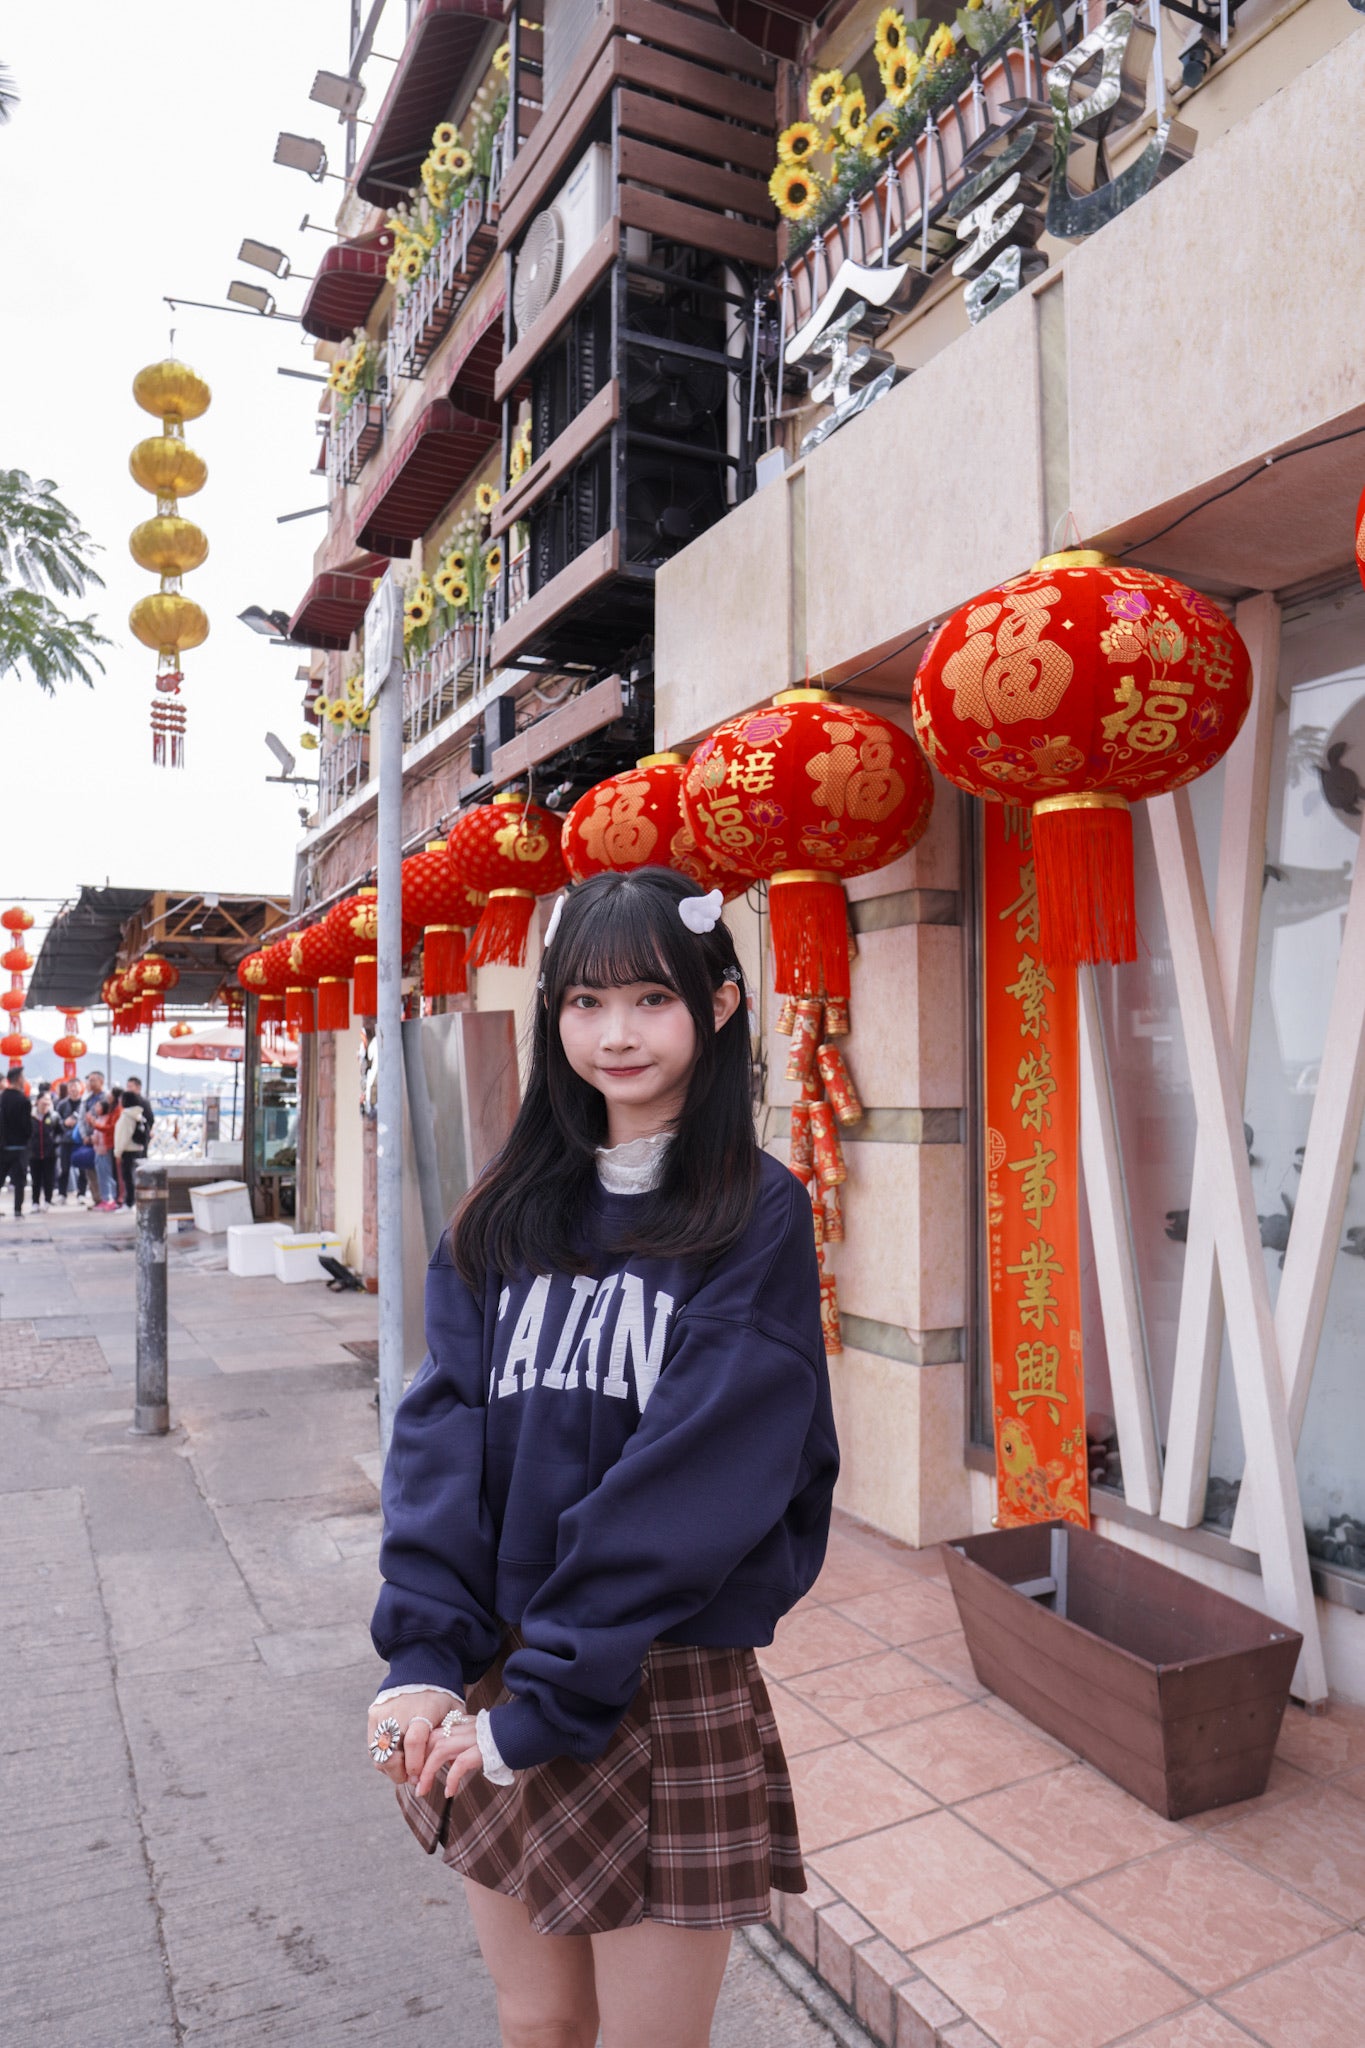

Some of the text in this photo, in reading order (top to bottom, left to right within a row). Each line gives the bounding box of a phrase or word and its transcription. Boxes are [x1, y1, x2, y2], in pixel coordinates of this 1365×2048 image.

[941, 585, 1074, 729] 福
[1101, 674, 1195, 752] 福
[726, 749, 776, 794] 接
[805, 721, 905, 822] 福
[493, 811, 550, 863] 福
[577, 781, 659, 866] 福
[697, 794, 755, 849] 福
[488, 1272, 686, 1414] AIRN
